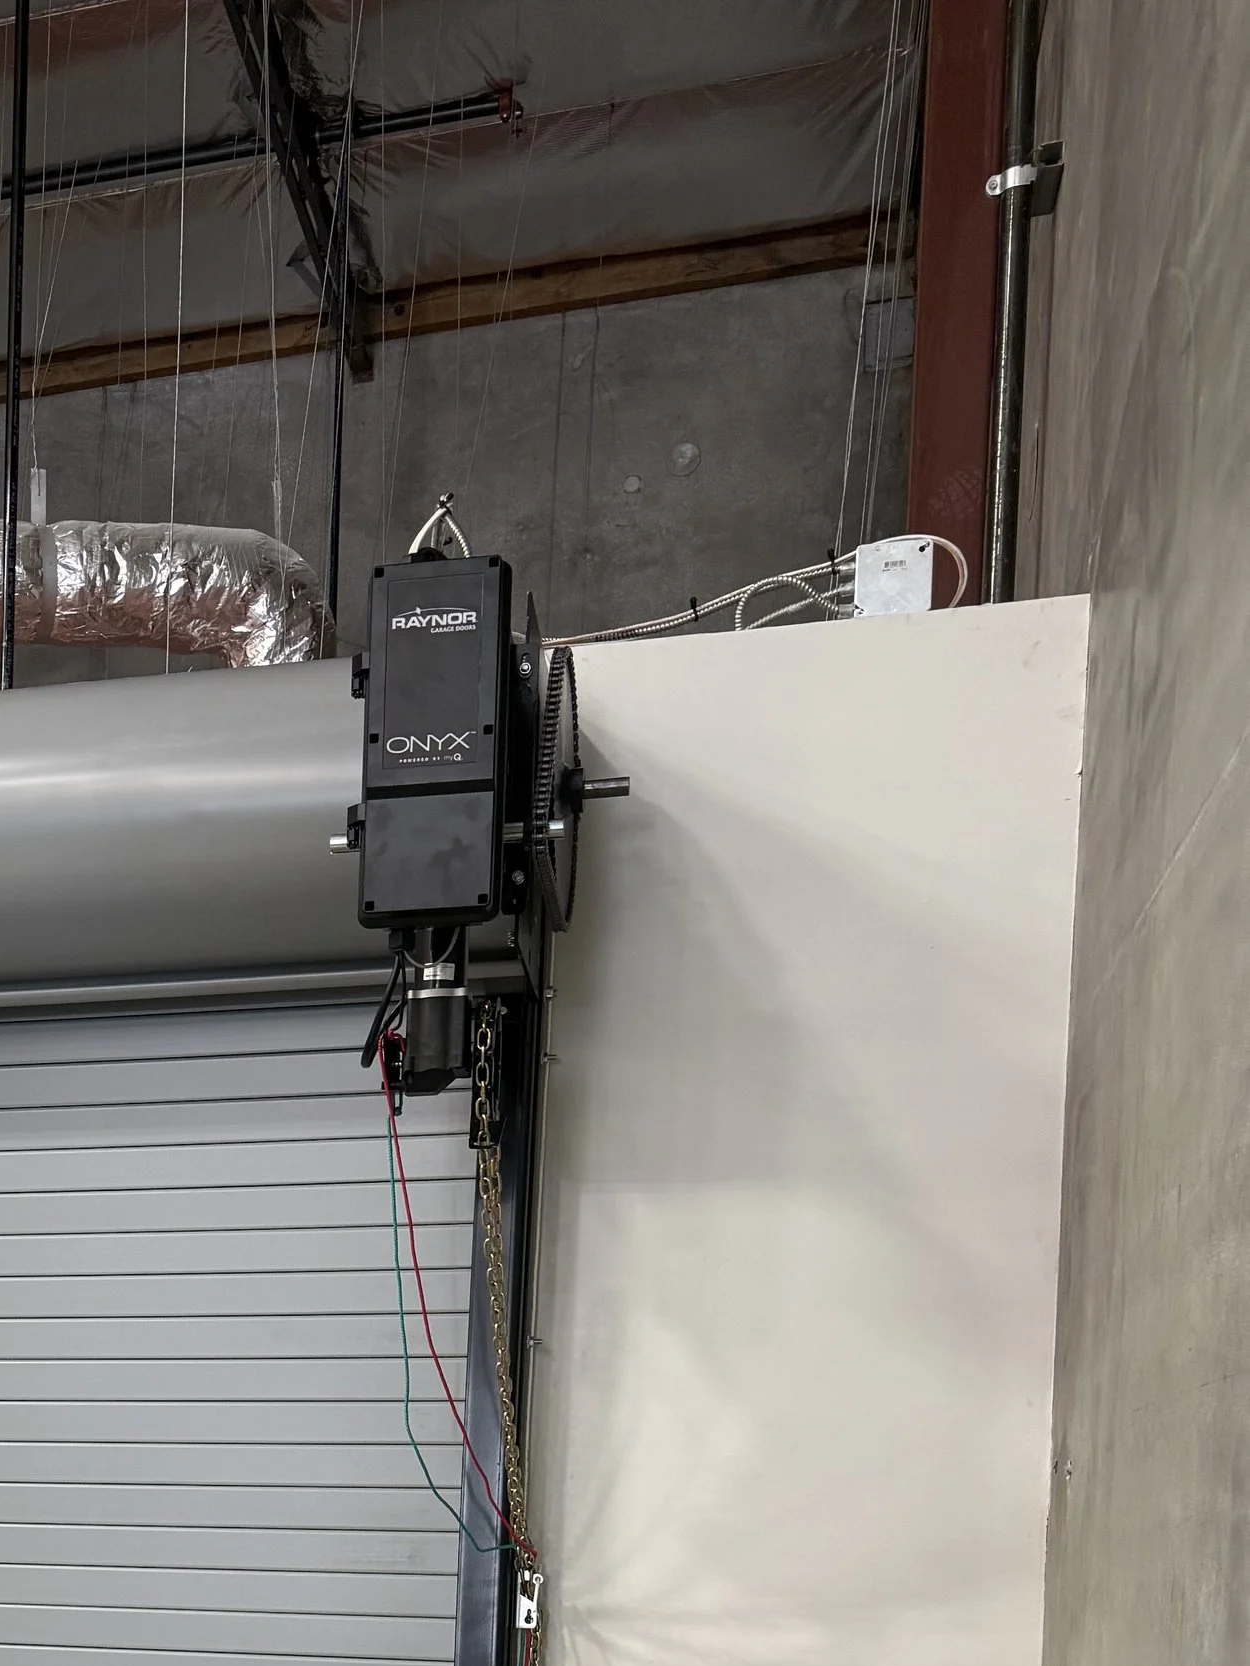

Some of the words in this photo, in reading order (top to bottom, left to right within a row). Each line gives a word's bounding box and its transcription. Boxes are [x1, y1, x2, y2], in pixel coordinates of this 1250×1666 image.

[392, 611, 477, 630] RAYNOR
[455, 624, 477, 632] DOORS
[386, 731, 470, 754] ONYX
